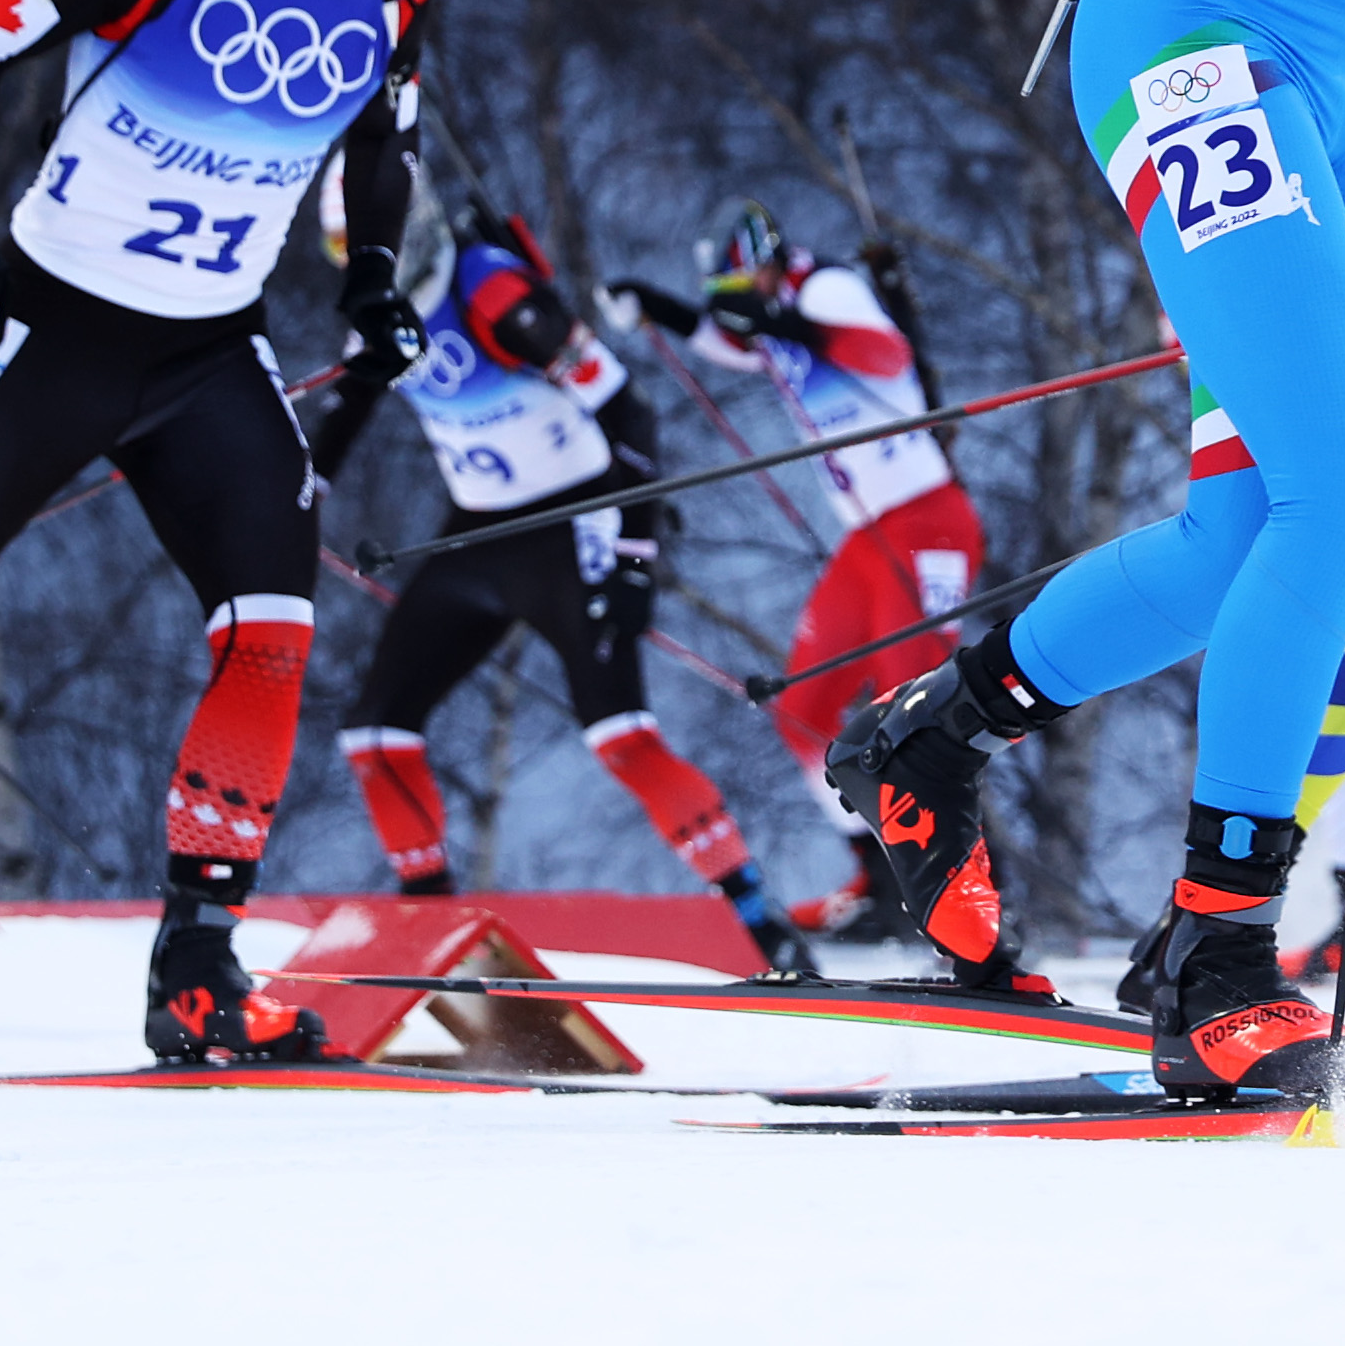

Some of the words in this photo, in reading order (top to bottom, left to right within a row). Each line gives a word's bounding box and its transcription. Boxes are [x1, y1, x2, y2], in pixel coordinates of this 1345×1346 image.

[107, 102, 253, 182] BEIJING
[1157, 124, 1272, 232] 23
[123, 199, 257, 273] 21
[1197, 219, 1229, 239] BEIJING
[1230, 208, 1261, 224] 2022
